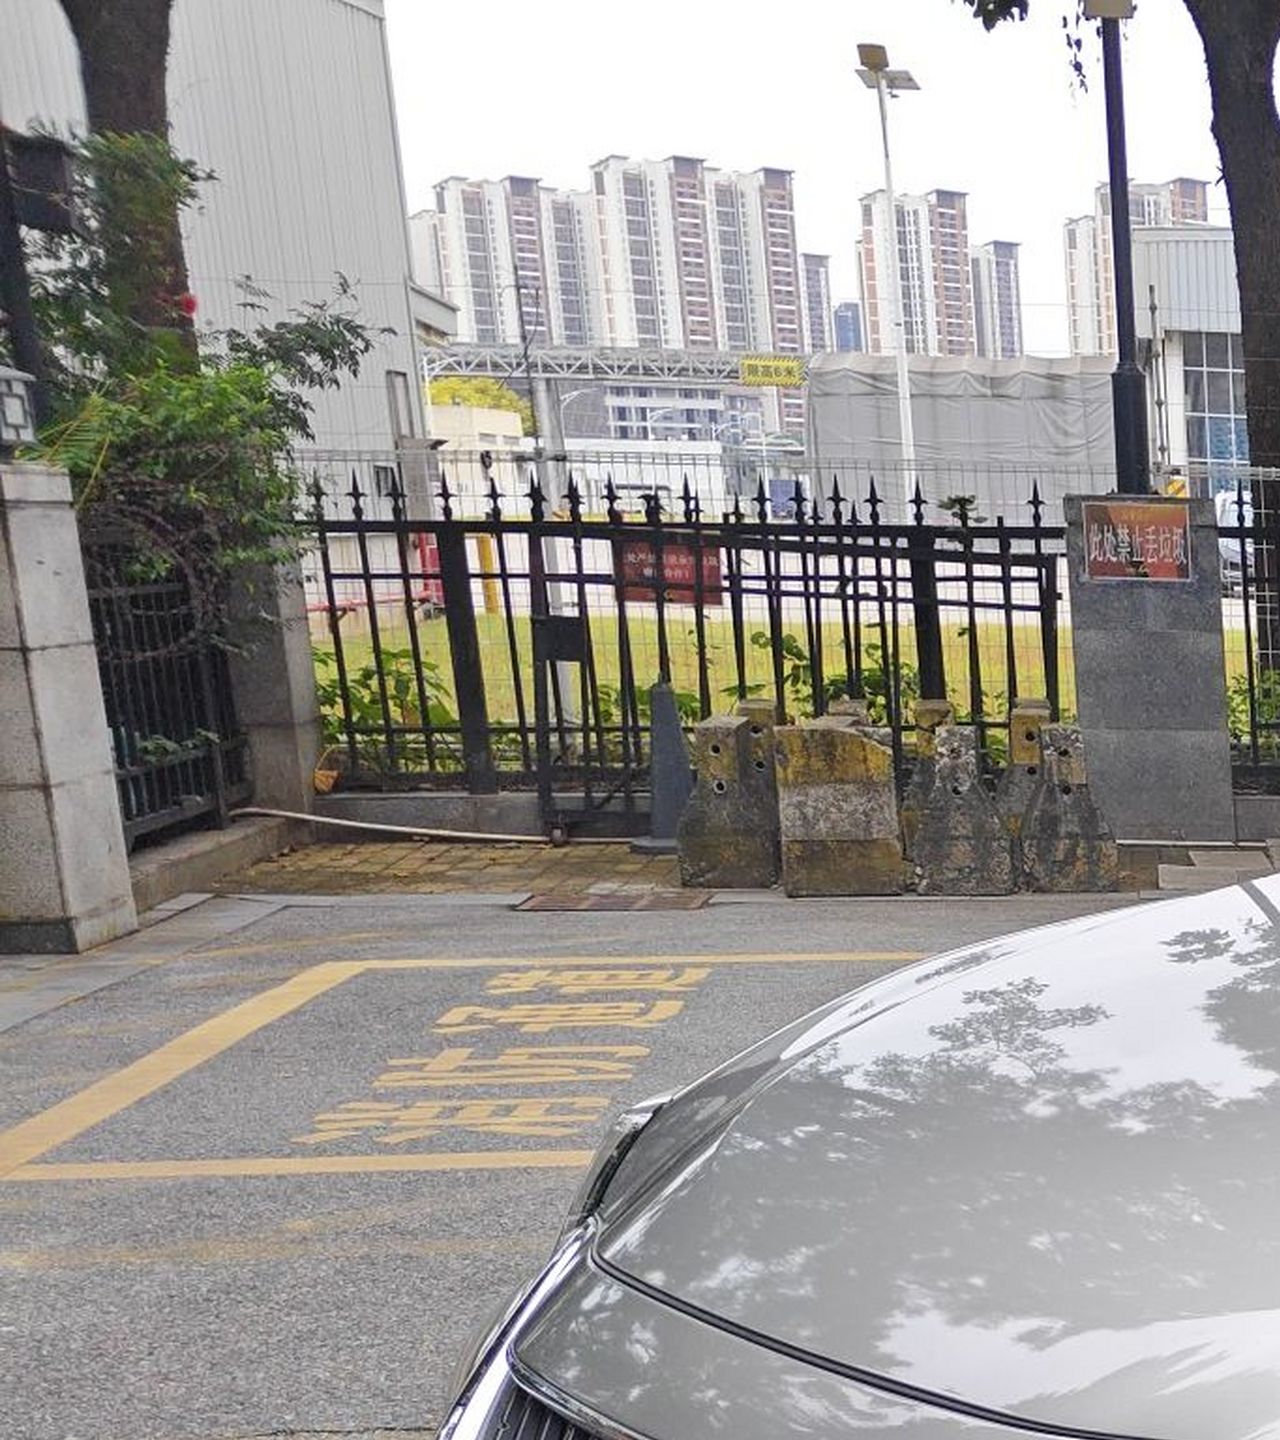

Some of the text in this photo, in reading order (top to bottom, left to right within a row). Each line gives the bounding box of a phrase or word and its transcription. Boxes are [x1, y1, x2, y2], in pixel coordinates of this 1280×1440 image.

[746, 363, 796, 378] 限高6米
[1090, 523, 1187, 565] 此处禁止丢垃圾
[291, 966, 712, 1144] 消防通道
